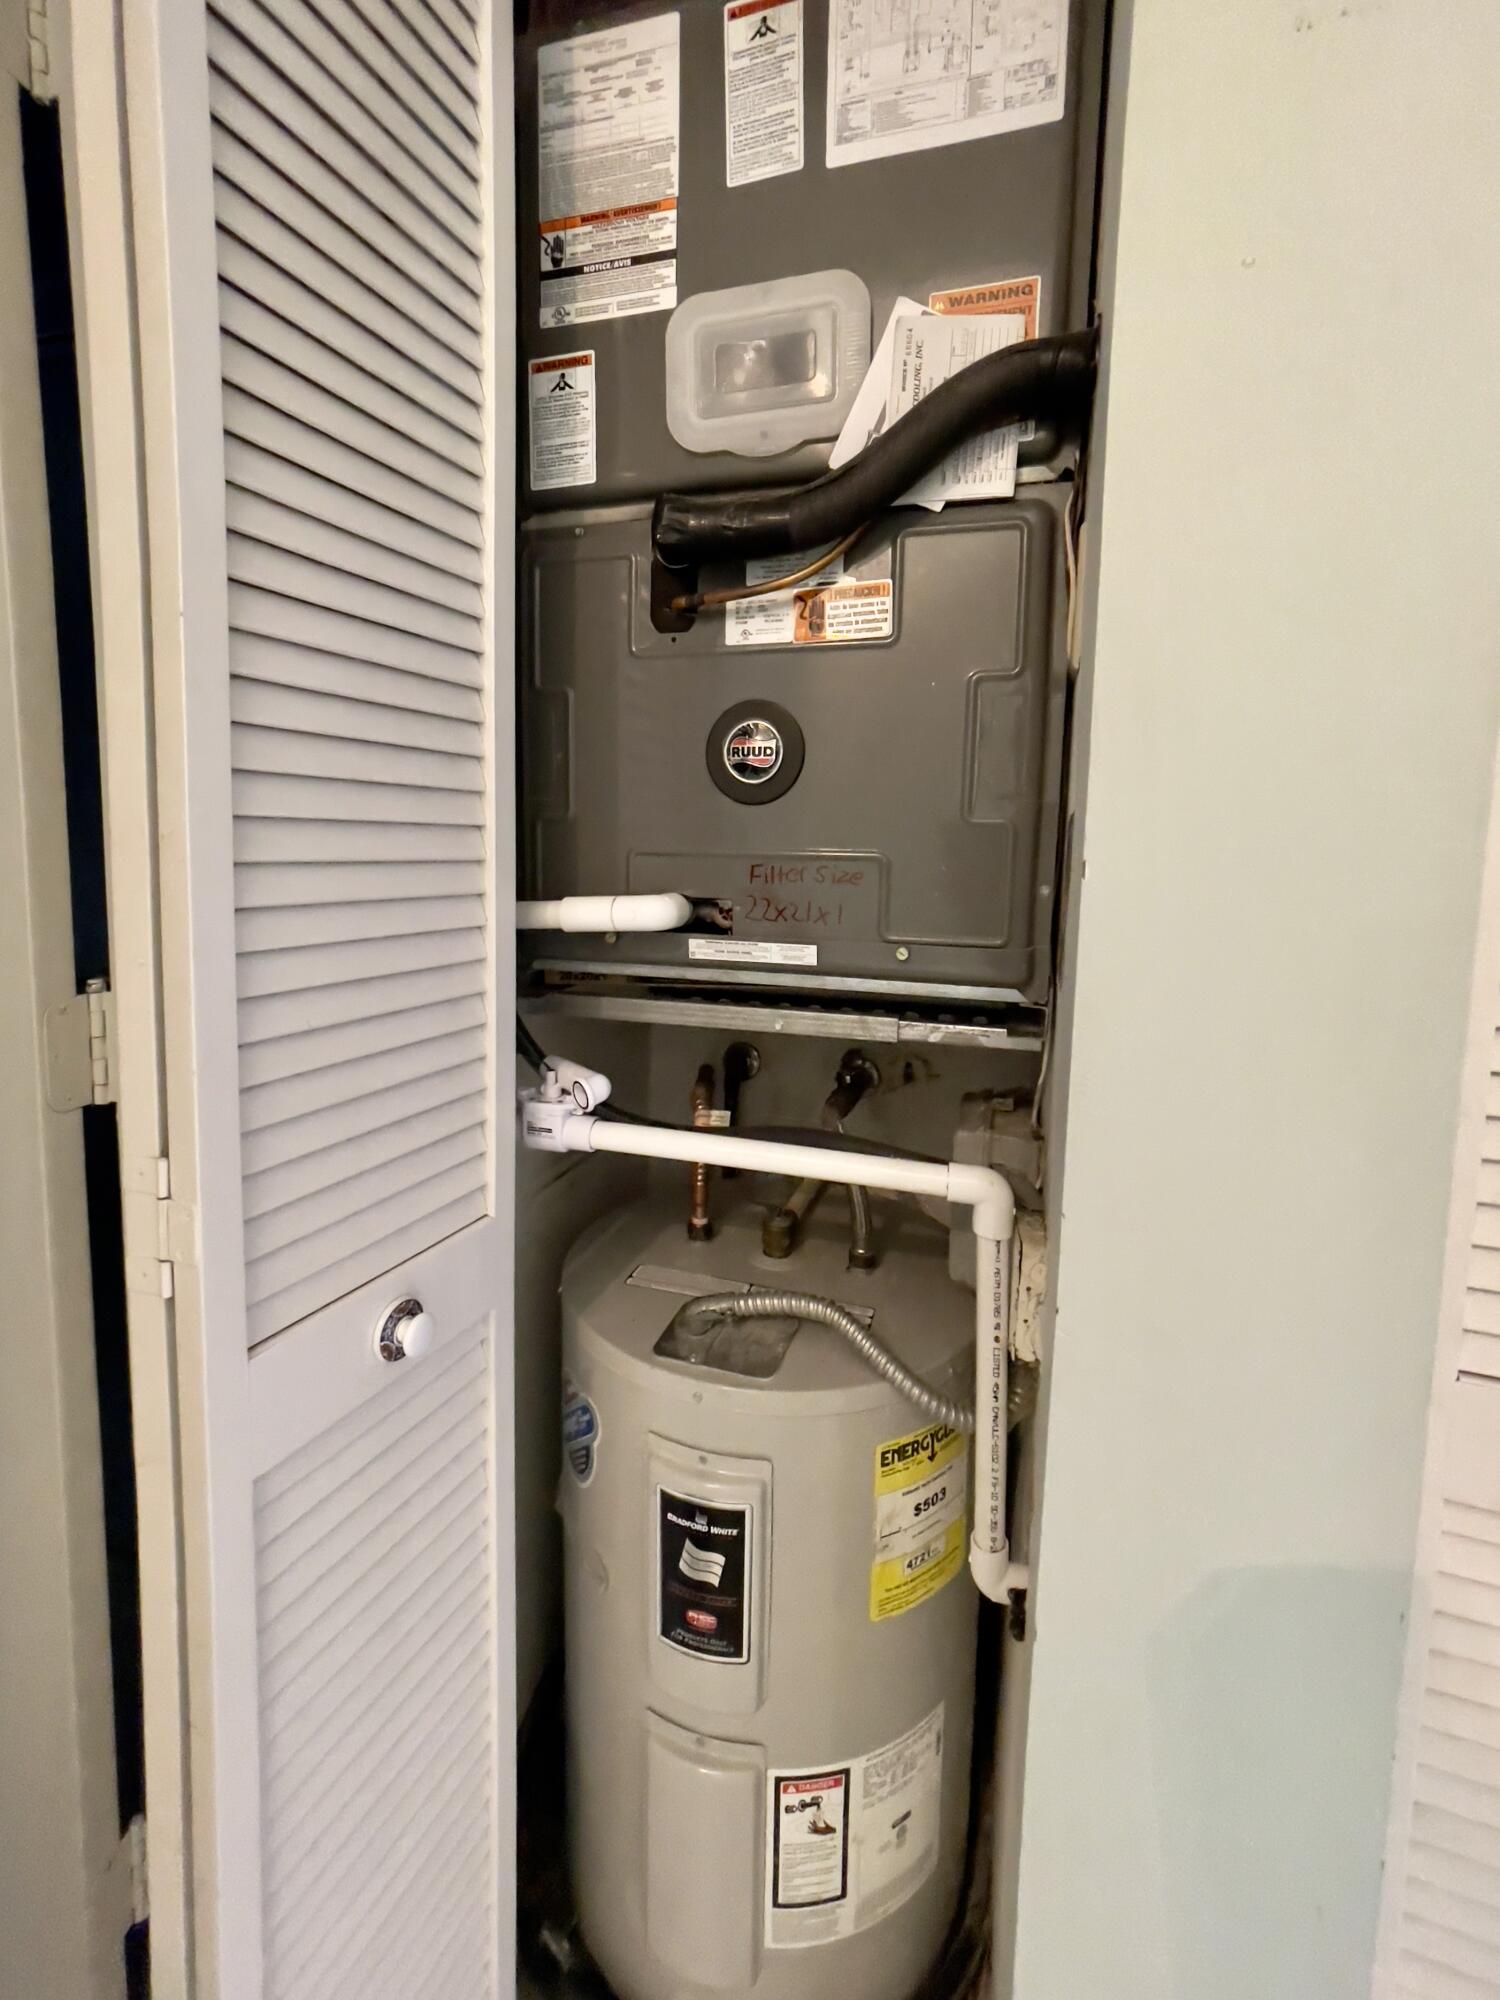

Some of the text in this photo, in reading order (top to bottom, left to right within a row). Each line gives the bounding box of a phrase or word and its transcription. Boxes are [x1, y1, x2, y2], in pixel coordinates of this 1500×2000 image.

[583, 258, 632, 274] NOTICE/AVIS
[948, 283, 1034, 308] WARNING
[731, 746, 774, 758] RUUD
[749, 863, 864, 886] Filter Size
[744, 894, 843, 926] 22x21x1
[666, 1511, 740, 1537] BRADFORD WHITE
